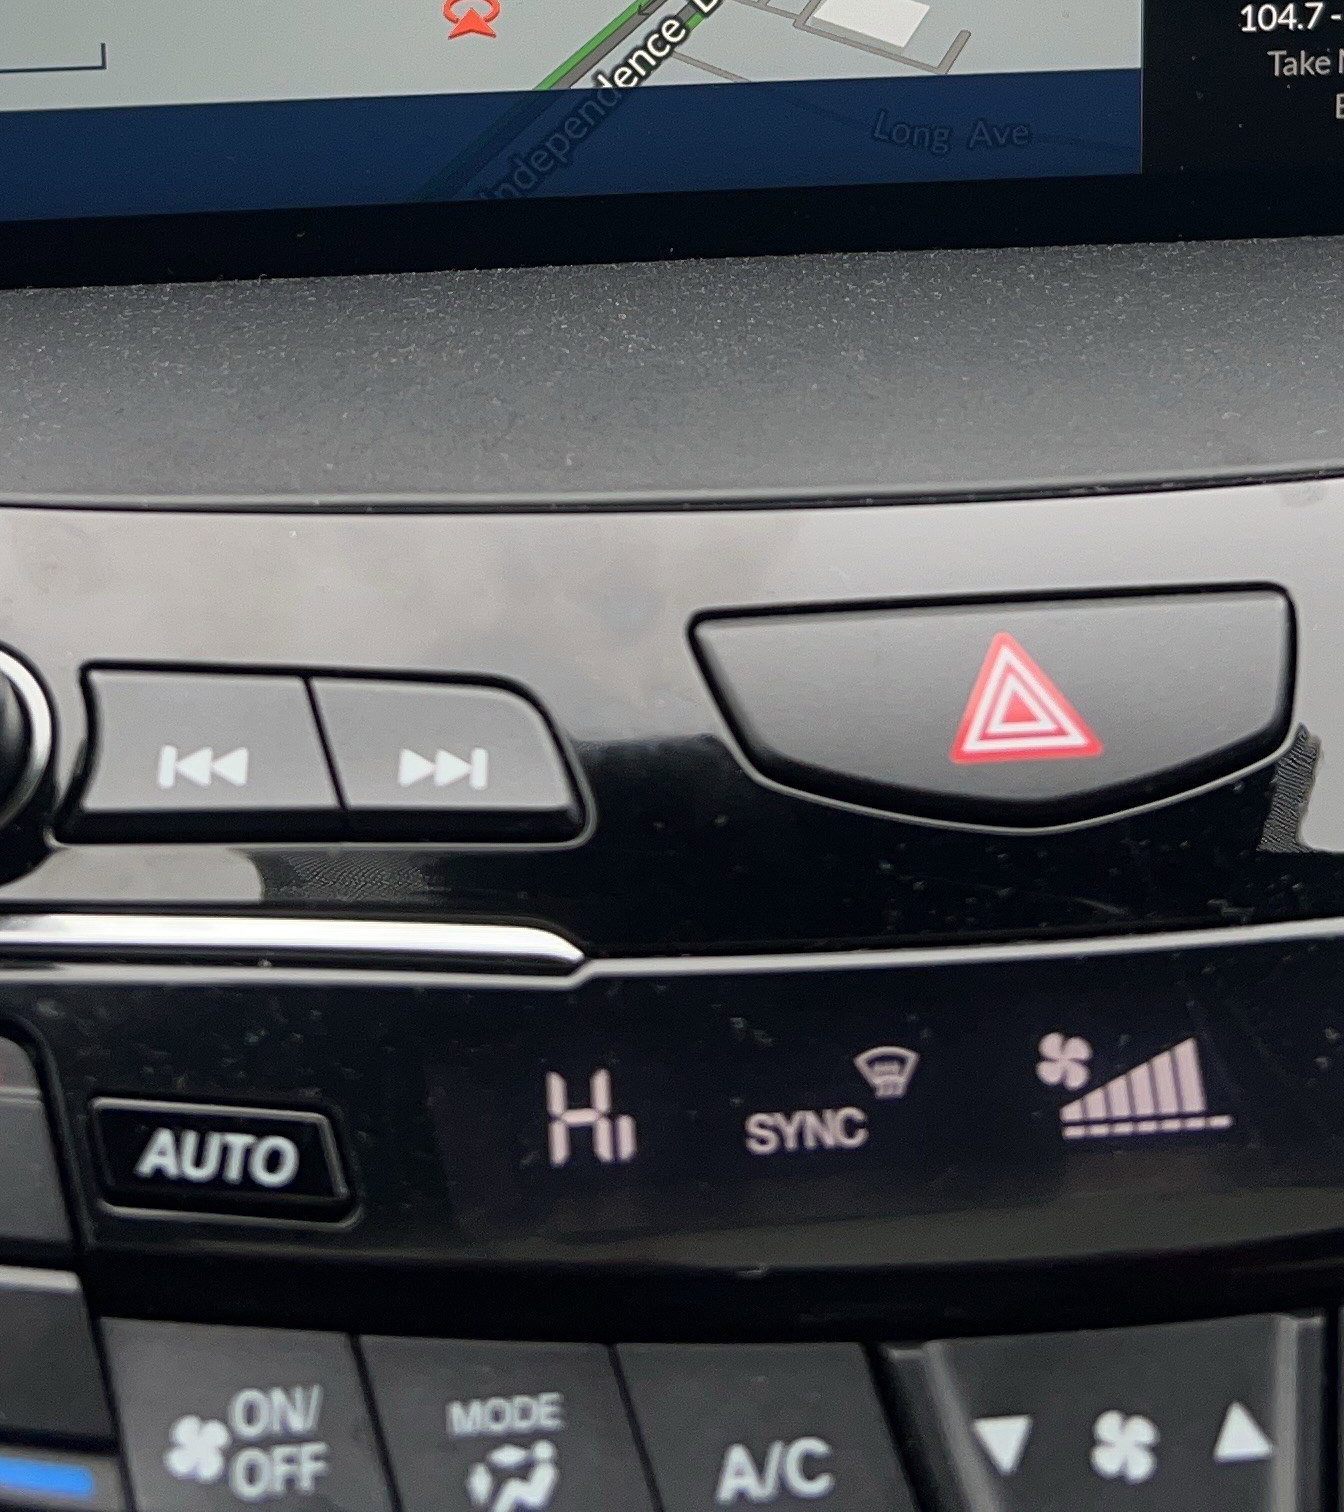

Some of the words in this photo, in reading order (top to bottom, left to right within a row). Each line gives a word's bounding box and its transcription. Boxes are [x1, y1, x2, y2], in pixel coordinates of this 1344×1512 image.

[1239, 1, 1324, 32] 104.7
[1267, 48, 1331, 77] Take
[873, 110, 951, 154] Long
[968, 119, 1030, 149] Ave
[744, 1106, 869, 1155] SYNC
[134, 1126, 300, 1188] AUTO
[446, 1391, 566, 1439] MODE
[228, 1441, 330, 1501] OFF
[716, 1436, 835, 1506] A/C
